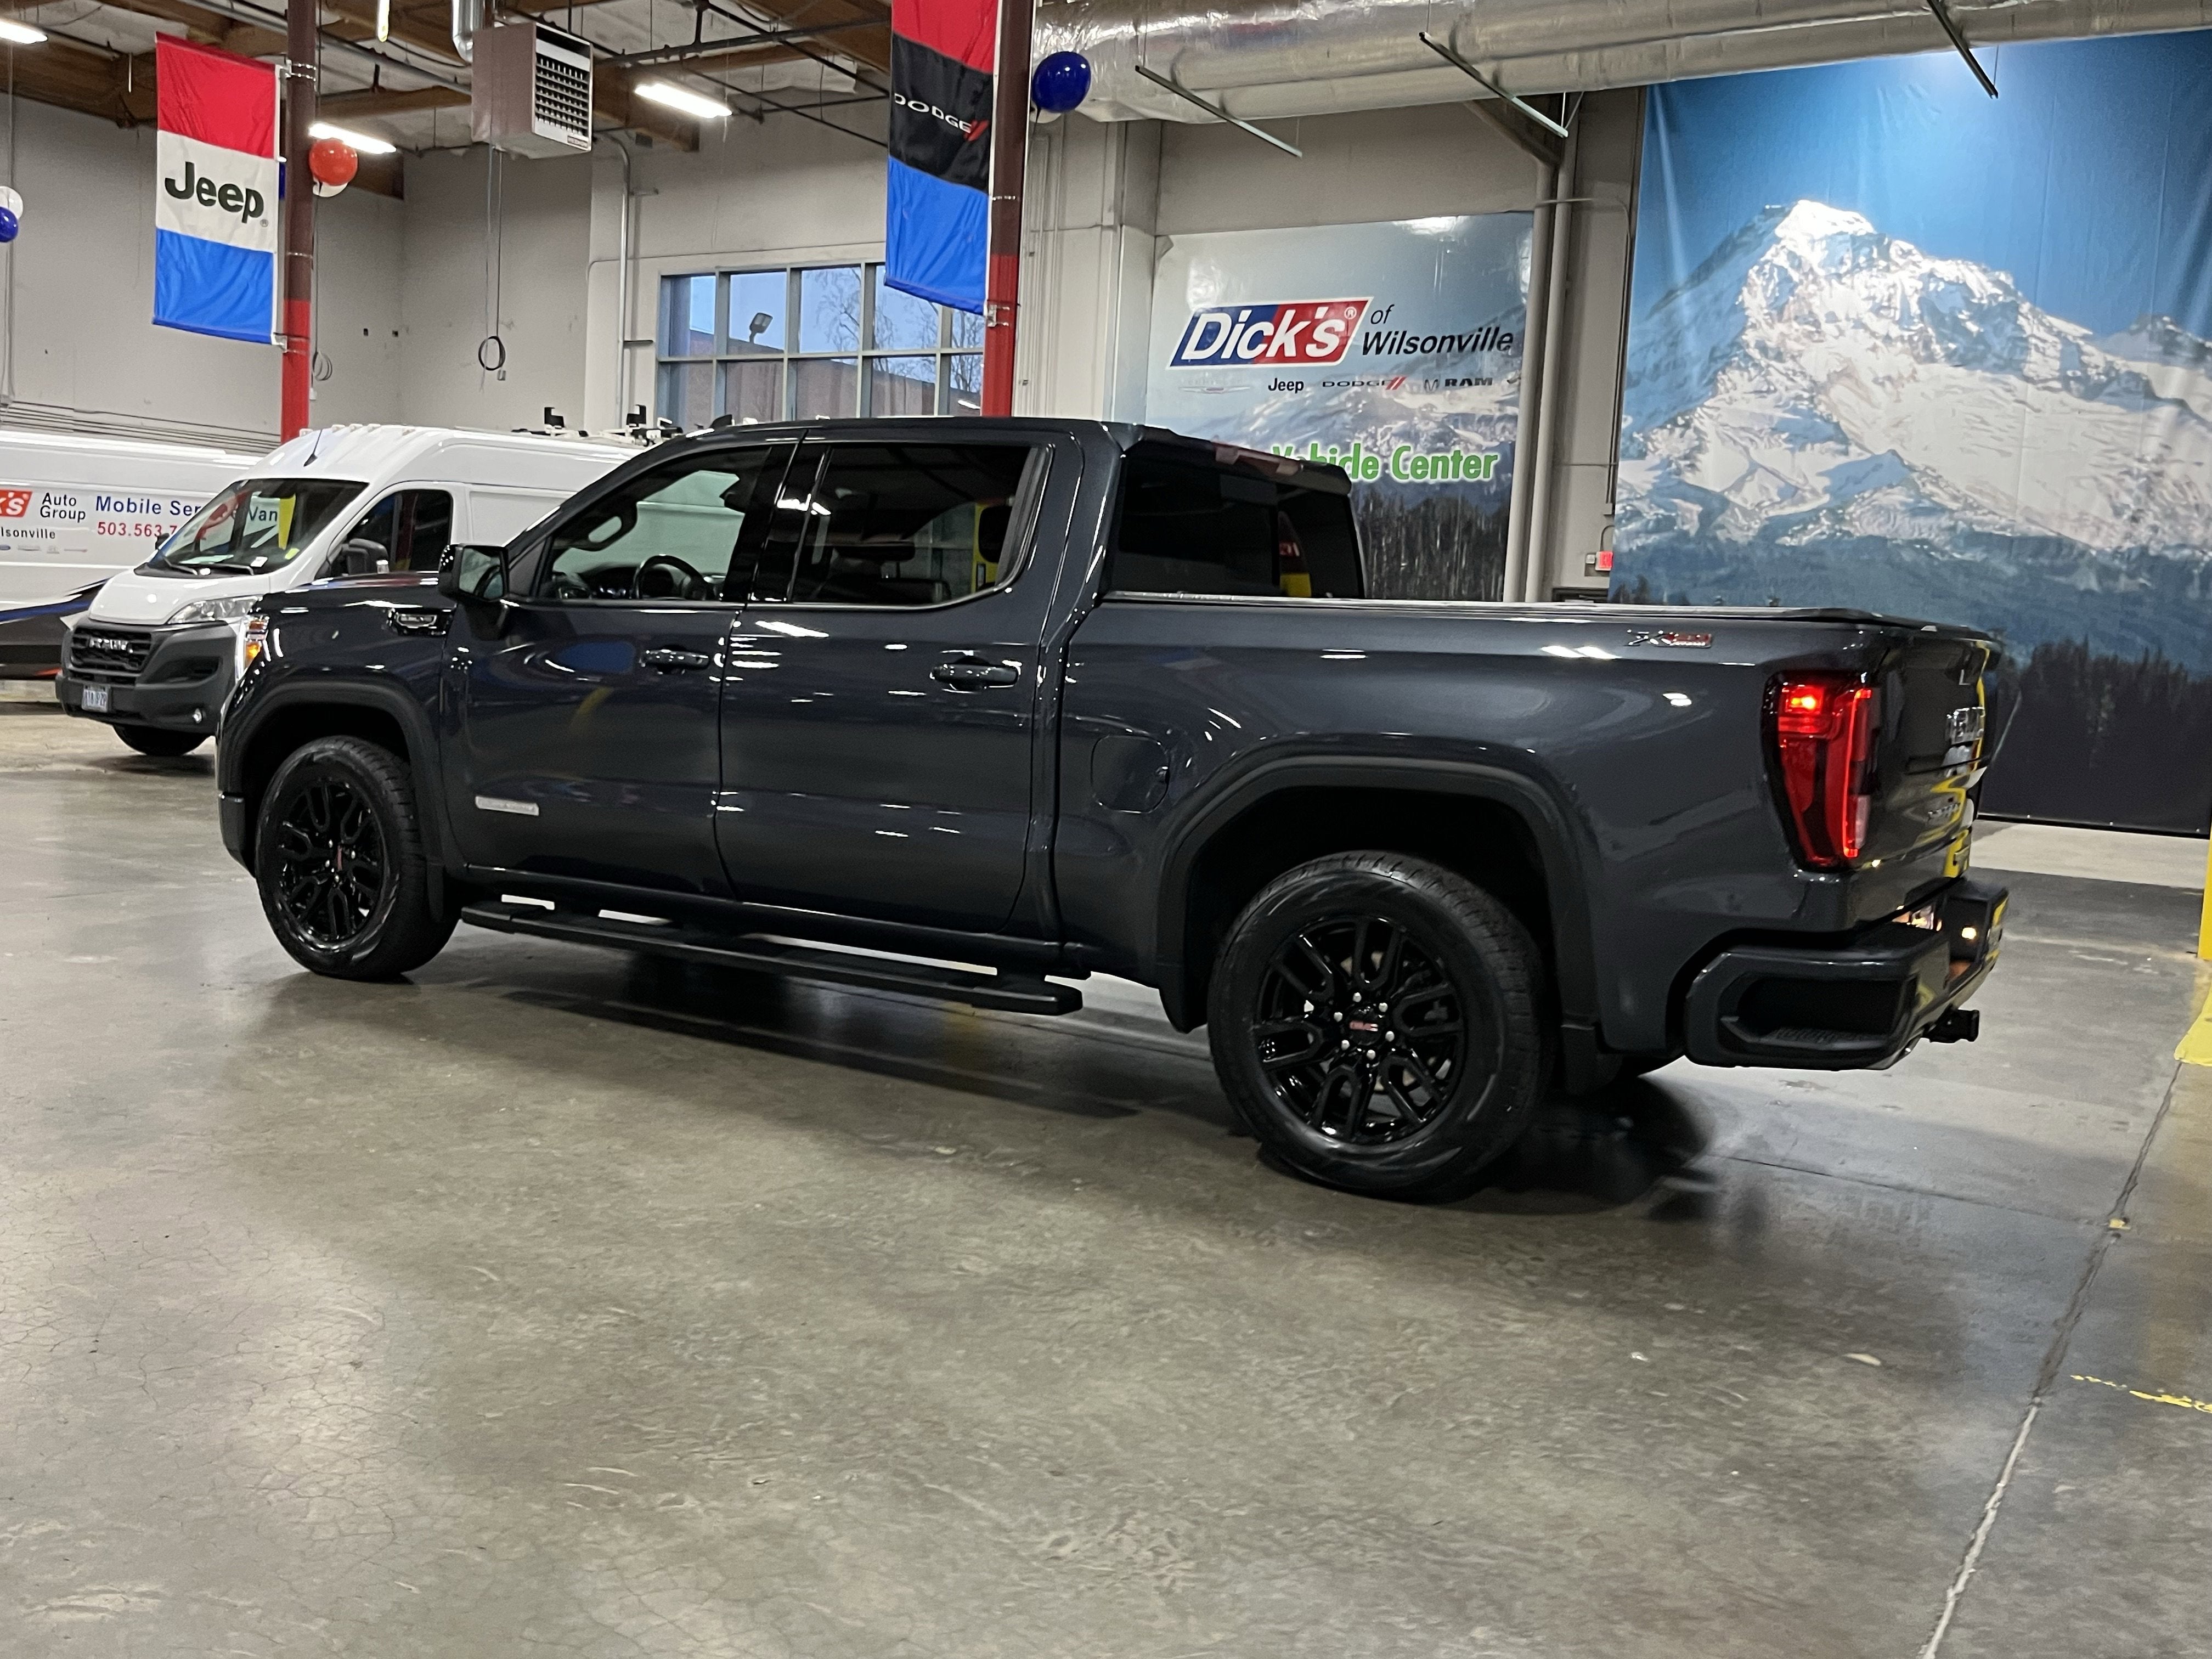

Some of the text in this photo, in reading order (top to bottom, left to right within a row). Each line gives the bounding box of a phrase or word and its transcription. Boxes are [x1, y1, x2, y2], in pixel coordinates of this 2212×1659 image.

[894, 93, 972, 133] DODGE
[165, 161, 264, 223] Jeep
[1181, 304, 1395, 360] Dick's of
[1362, 326, 1514, 356] Wilsonville
[1268, 378, 1304, 393] Jeep
[1444, 377, 1493, 387] RAM
[1392, 445, 1498, 480] Center
[42, 493, 77, 507] Auto
[96, 496, 162, 515] Mobile
[170, 500, 201, 516] Ser
[40, 505, 86, 523] Group
